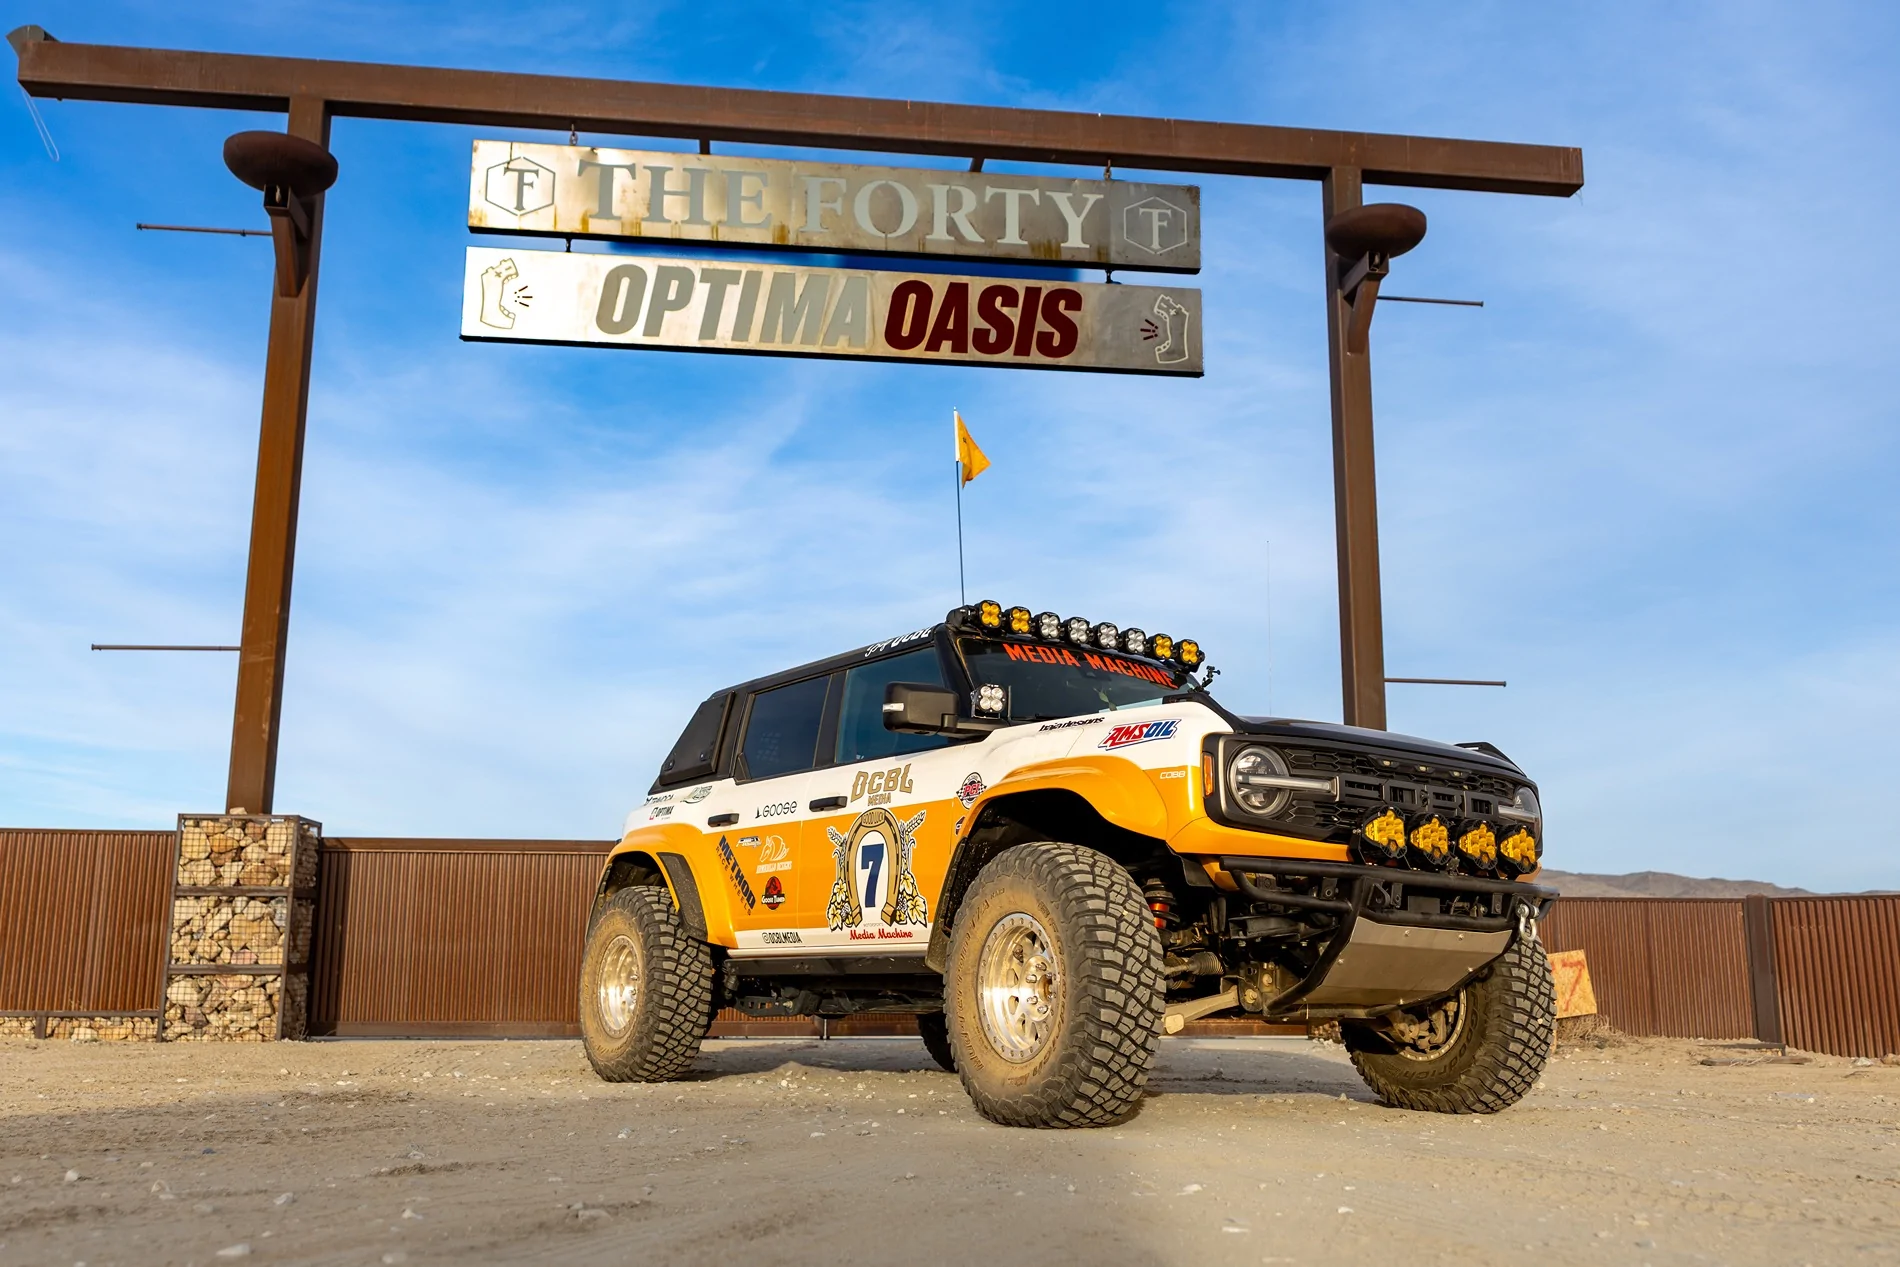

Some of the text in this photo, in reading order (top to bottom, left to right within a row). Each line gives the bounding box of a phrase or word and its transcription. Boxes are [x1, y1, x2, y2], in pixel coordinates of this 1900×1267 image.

[577, 159, 1104, 249] THE FORTY
[595, 263, 1083, 359] OPTIMA OASIS
[1002, 643, 1179, 690] MEDIA MACHINE
[1102, 720, 1176, 748] AMSOIL
[851, 763, 914, 803] DCBL
[963, 783, 981, 797] PCI
[1160, 771, 1186, 780] COBB
[868, 792, 891, 807] MEDIA
[715, 846, 752, 916] RACE WHEELS
[719, 835, 756, 910] METHOD
[861, 843, 885, 908] 7
[849, 928, 914, 941] Media Machine
